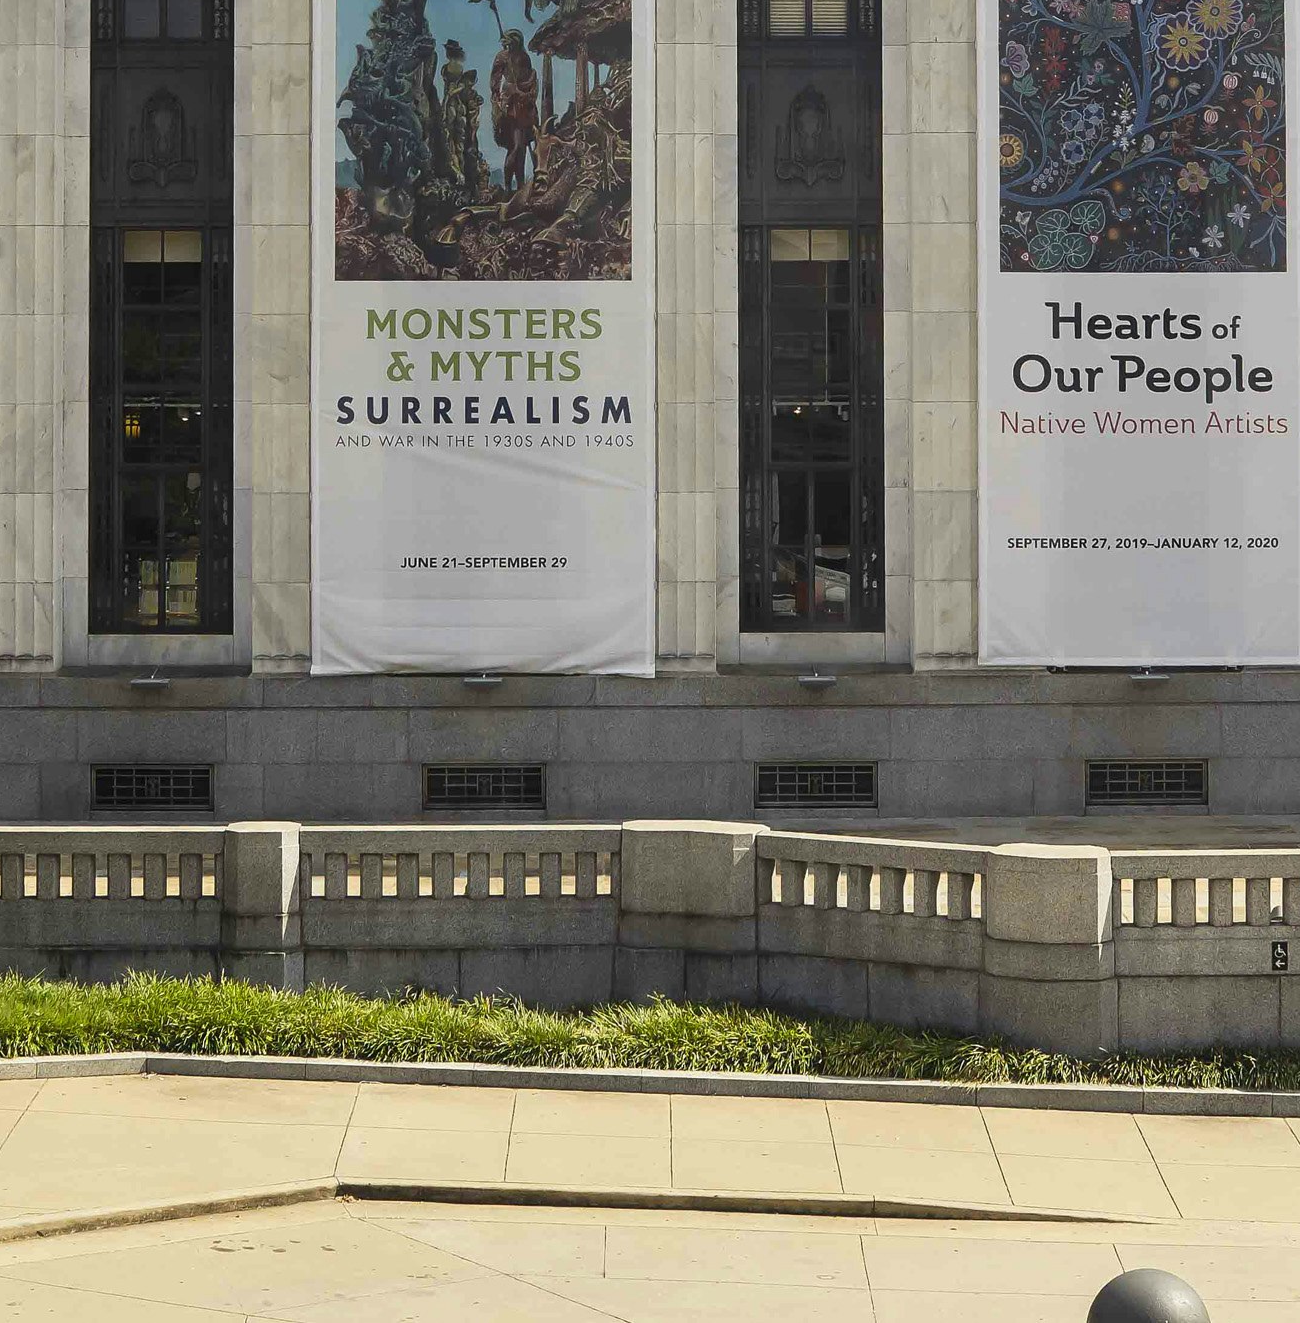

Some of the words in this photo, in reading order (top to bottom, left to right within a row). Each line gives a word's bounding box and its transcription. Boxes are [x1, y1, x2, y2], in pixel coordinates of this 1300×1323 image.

[367, 309, 602, 339] MONSTERS
[1045, 302, 1201, 339] Hearts
[1212, 316, 1241, 339] of
[387, 352, 414, 381] &
[431, 351, 580, 381] MYTHS
[1013, 355, 1103, 392] Our
[1110, 354, 1272, 404] People
[337, 396, 631, 424] SURREALISM
[1000, 411, 1085, 434] Native
[1093, 412, 1195, 434] Women
[1205, 411, 1288, 433] Artists
[335, 434, 371, 448] AND
[378, 434, 414, 448] WAR
[422, 434, 439, 448] IN
[446, 434, 475, 448] THE
[484, 434, 533, 448] 1930S
[539, 434, 576, 448] AND
[585, 434, 634, 448] 1940S
[1007, 537, 1088, 549] SEPTEMBER
[1091, 537, 1111, 551] 27,
[1223, 537, 1243, 550] 12,
[1246, 537, 1279, 549] 2020
[400, 557, 438, 569] JUNE
[550, 556, 568, 568] 29
